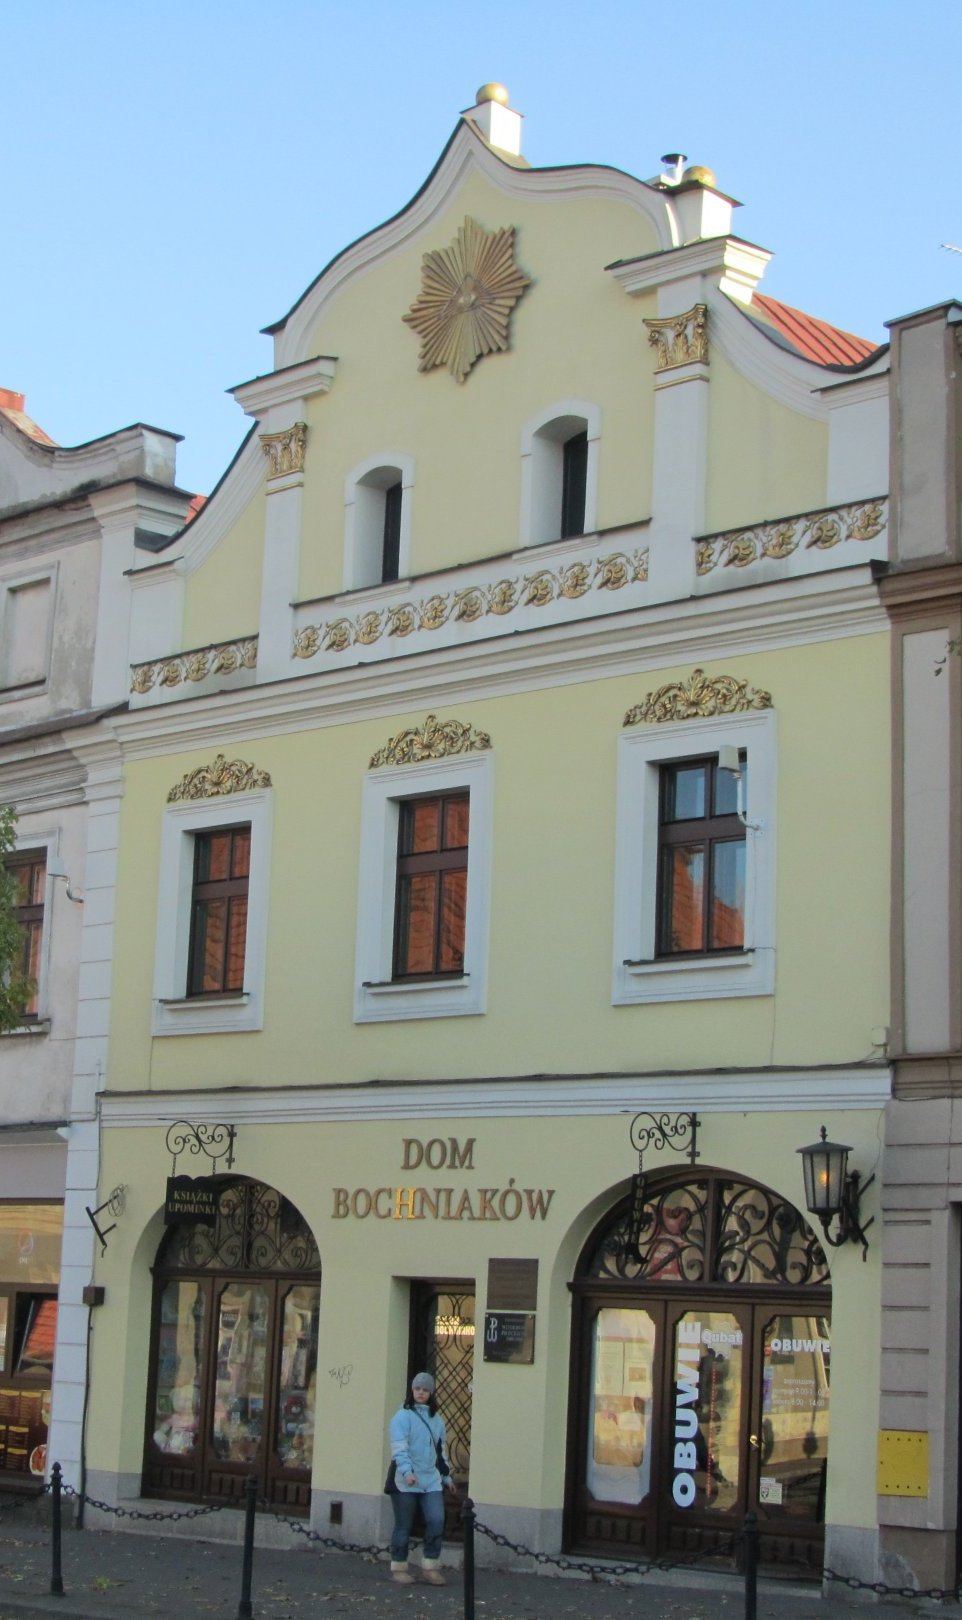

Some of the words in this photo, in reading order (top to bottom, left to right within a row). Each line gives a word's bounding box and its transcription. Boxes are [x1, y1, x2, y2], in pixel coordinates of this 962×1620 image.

[401, 1137, 477, 1170] DOM
[174, 1189, 213, 1203] KSIĄŻKI
[331, 1177, 556, 1221] BOCHNIAKÓW
[168, 1202, 216, 1215] UPOMINKI
[771, 1338, 831, 1353] OBUWIE
[672, 1321, 701, 1507] OBUWIE
